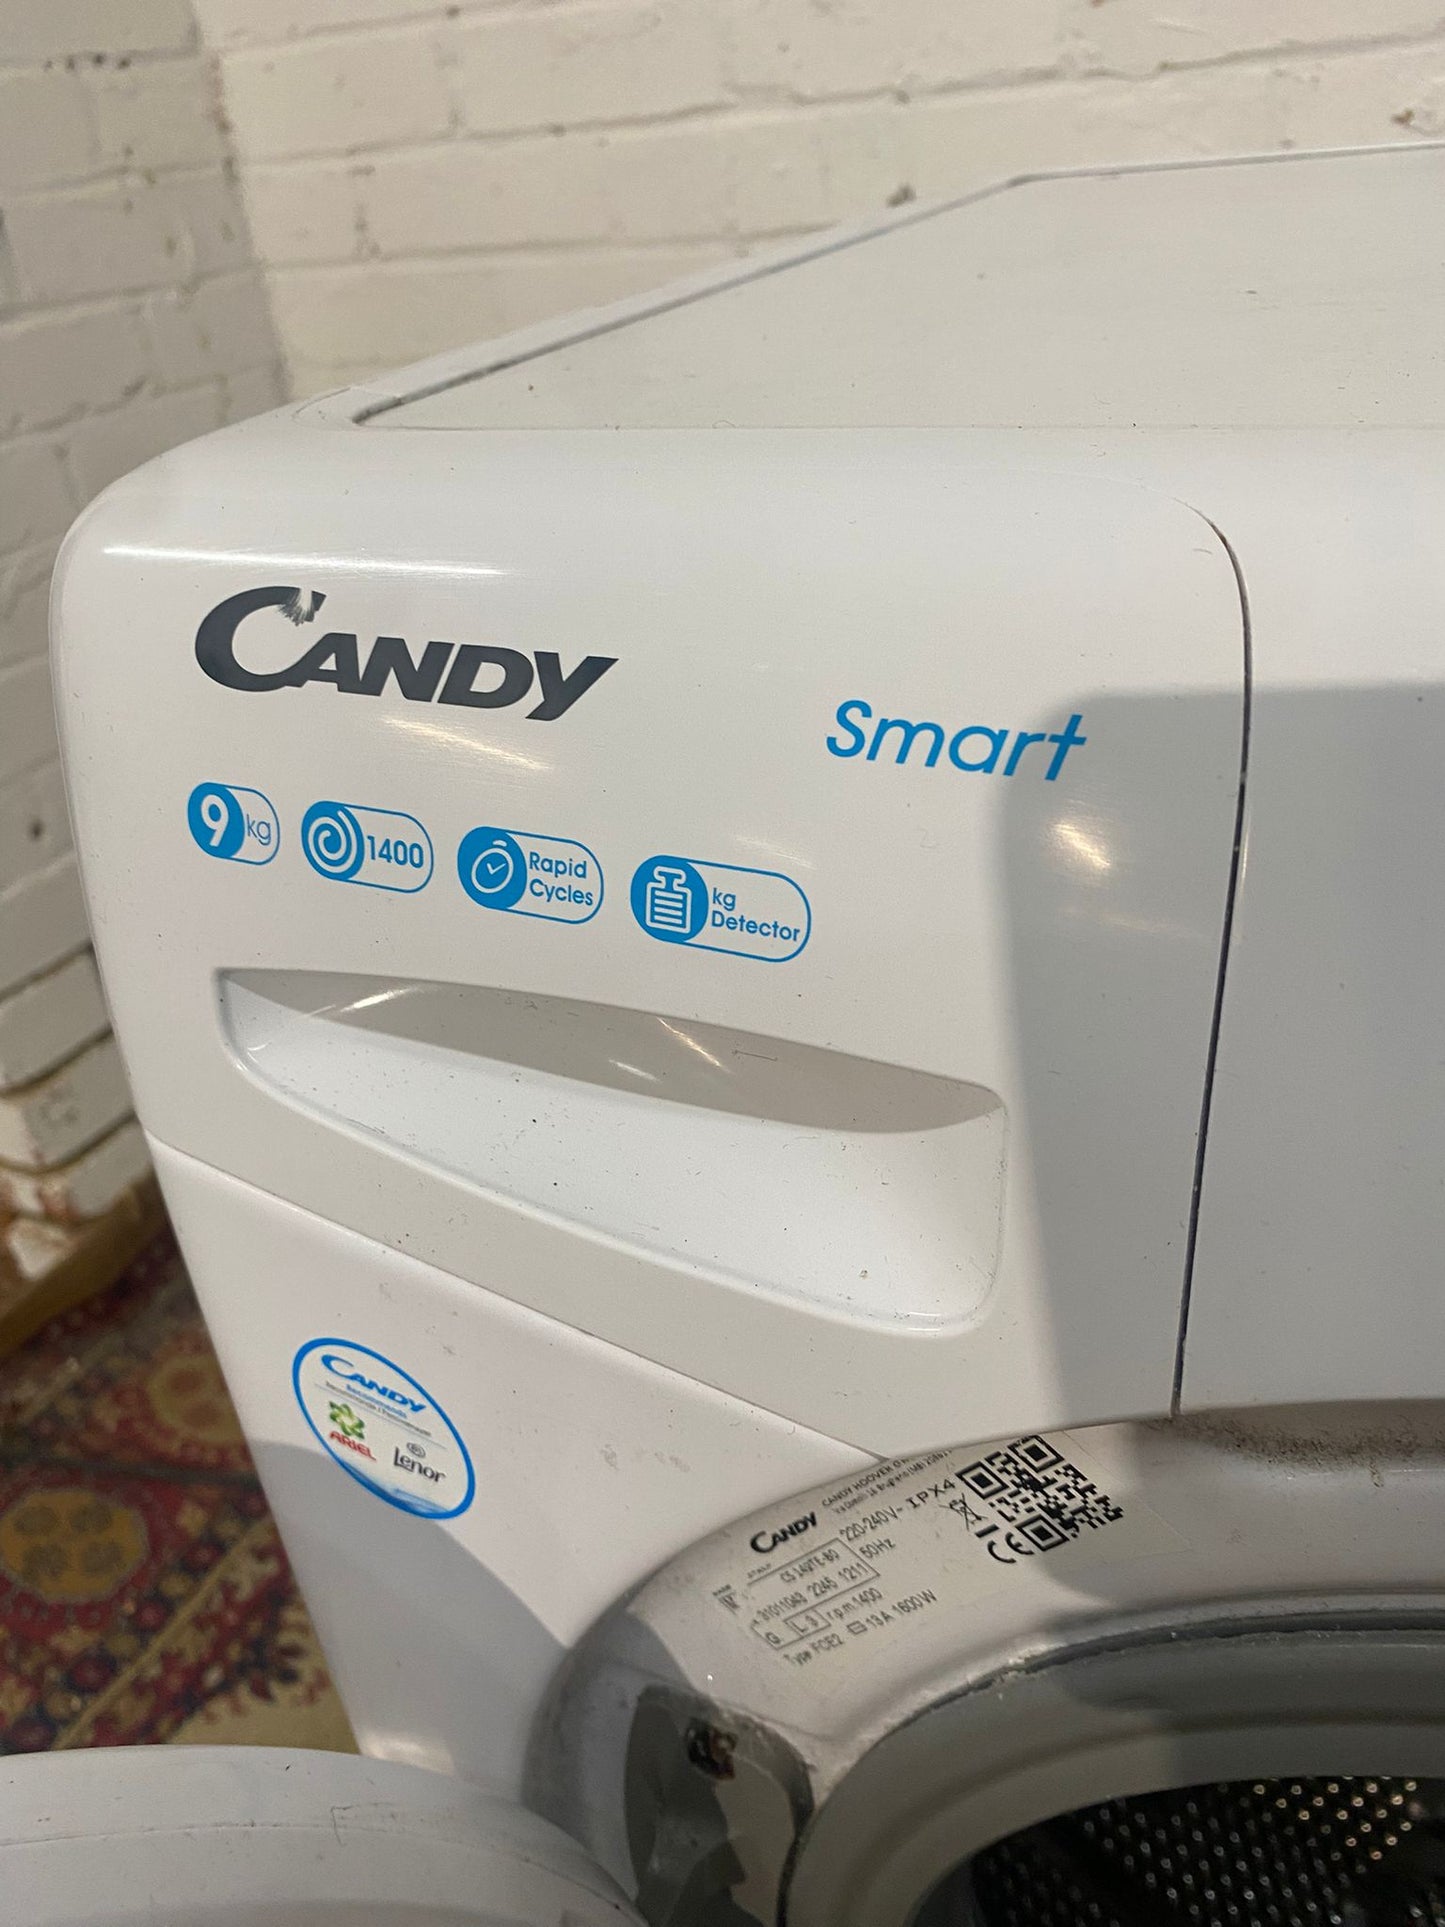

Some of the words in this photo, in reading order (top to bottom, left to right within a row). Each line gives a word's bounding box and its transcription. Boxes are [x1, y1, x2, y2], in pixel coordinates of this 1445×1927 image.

[195, 586, 619, 721] CANDY
[826, 699, 1087, 781] Smart
[200, 793, 229, 847] 9
[246, 814, 271, 846] kg
[366, 835, 424, 869] 1400
[528, 851, 587, 879] Rapid
[529, 878, 594, 906] Cycles
[711, 887, 736, 911] kg
[711, 910, 801, 942] Detector
[320, 1353, 427, 1413] CANDY
[329, 1430, 378, 1462] ARIEL
[393, 1446, 448, 1483] Lenor
[750, 1511, 818, 1554] CANDY
